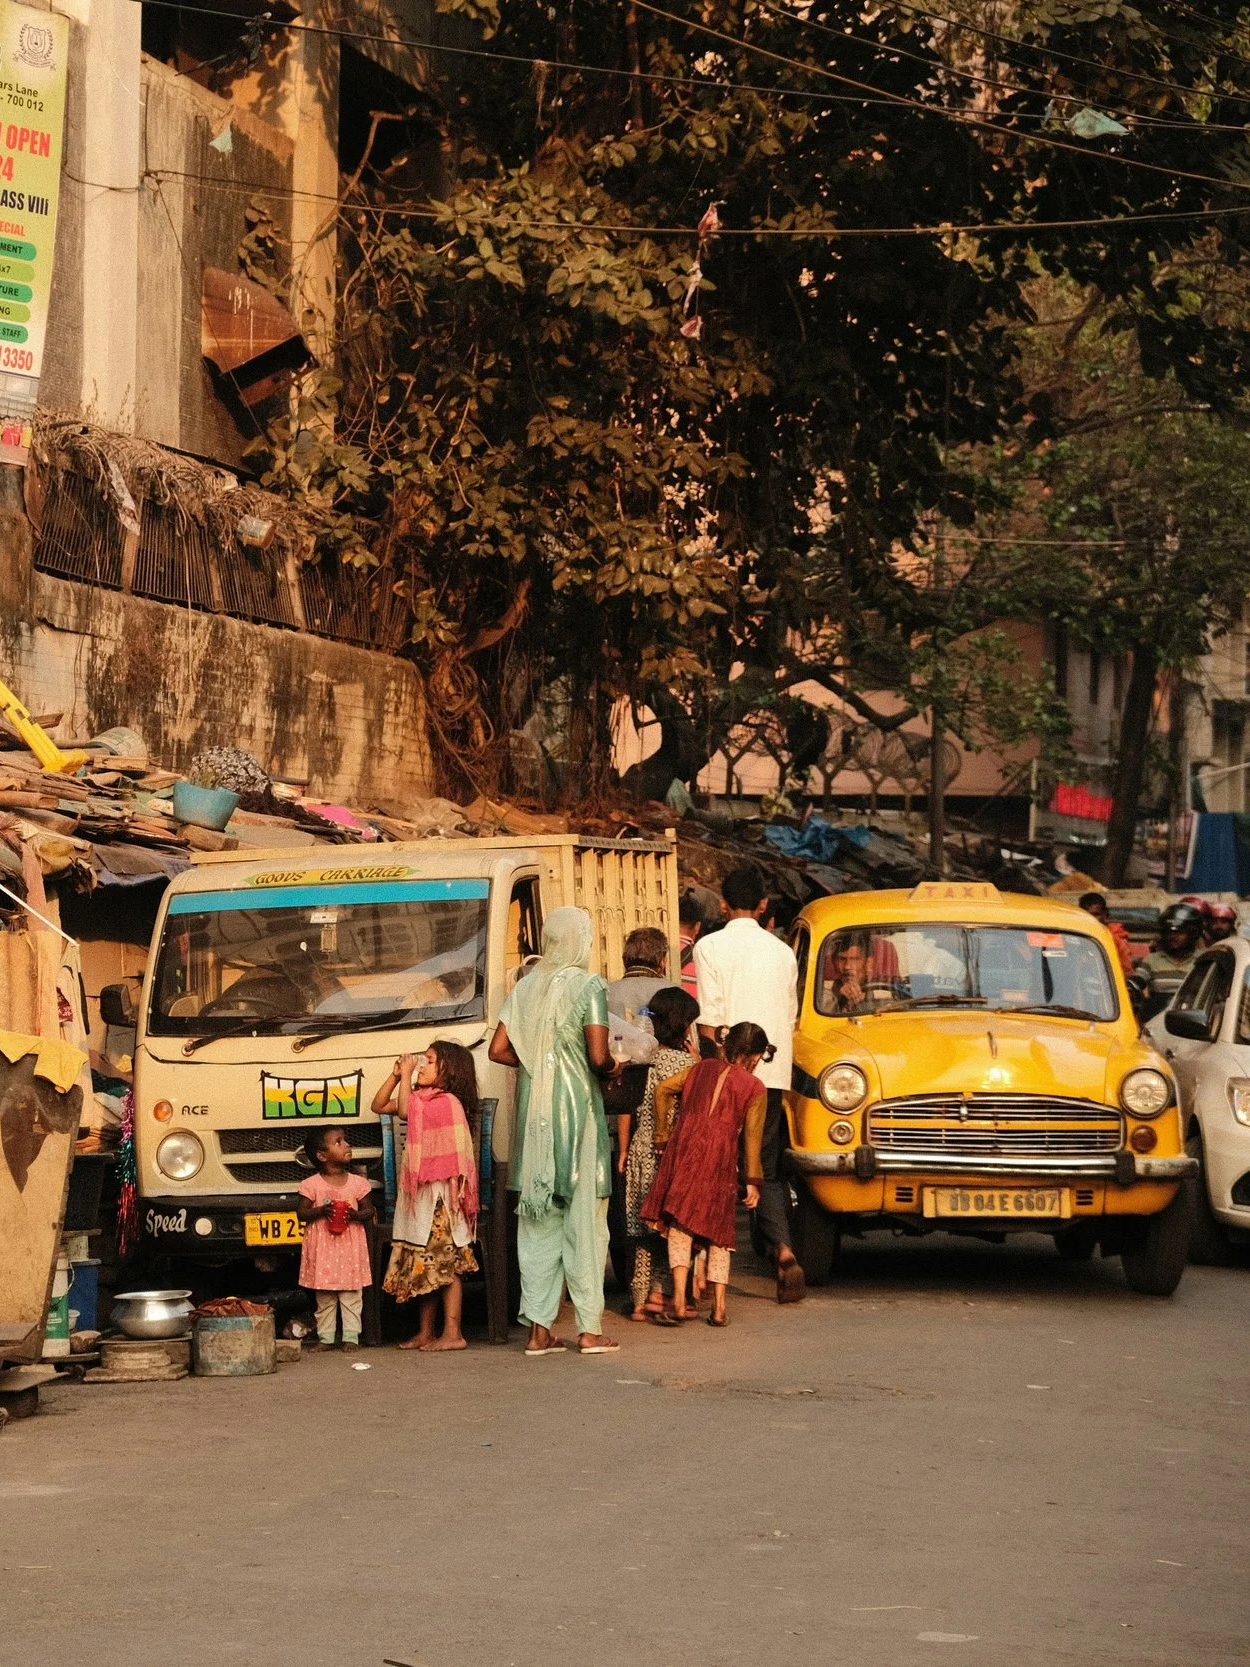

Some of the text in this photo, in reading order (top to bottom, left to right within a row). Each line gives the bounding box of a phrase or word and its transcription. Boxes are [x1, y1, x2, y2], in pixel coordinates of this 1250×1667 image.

[16, 84, 38, 98] Lane
[7, 94, 24, 107] 700
[27, 99, 44, 112] 012
[6, 124, 51, 157] OPEN
[28, 195, 49, 216] VIII
[2, 328, 21, 339] STAFF
[924, 886, 988, 898] TAXI
[261, 1073, 362, 1119] KGN
[181, 1105, 209, 1116] ACE
[974, 1194, 995, 1211] 04
[998, 1194, 1009, 1211] E
[145, 1208, 189, 1238] Speed
[259, 1219, 307, 1239] WB 25
